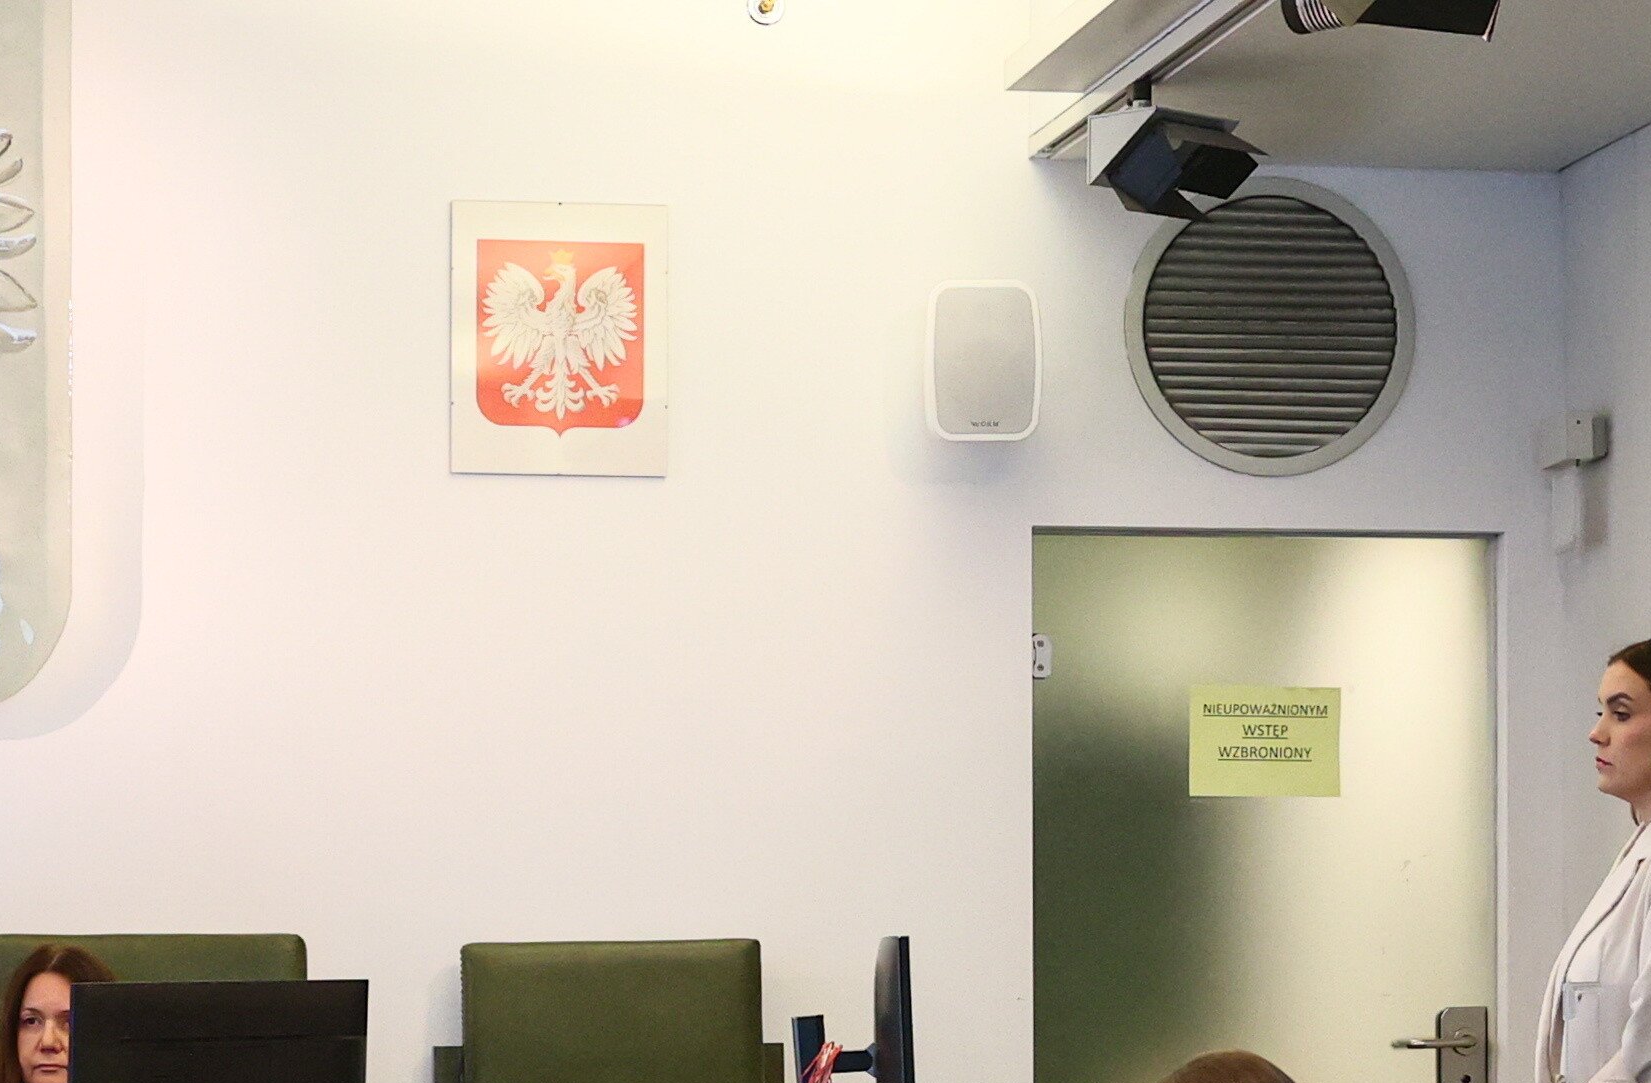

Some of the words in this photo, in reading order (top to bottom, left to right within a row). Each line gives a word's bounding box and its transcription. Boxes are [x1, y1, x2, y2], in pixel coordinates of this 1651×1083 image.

[1202, 703, 1329, 716] NIEUPOWAŻNIONYM
[1242, 724, 1289, 738] WSTĘP
[1217, 745, 1312, 759] WZBRONIONY
